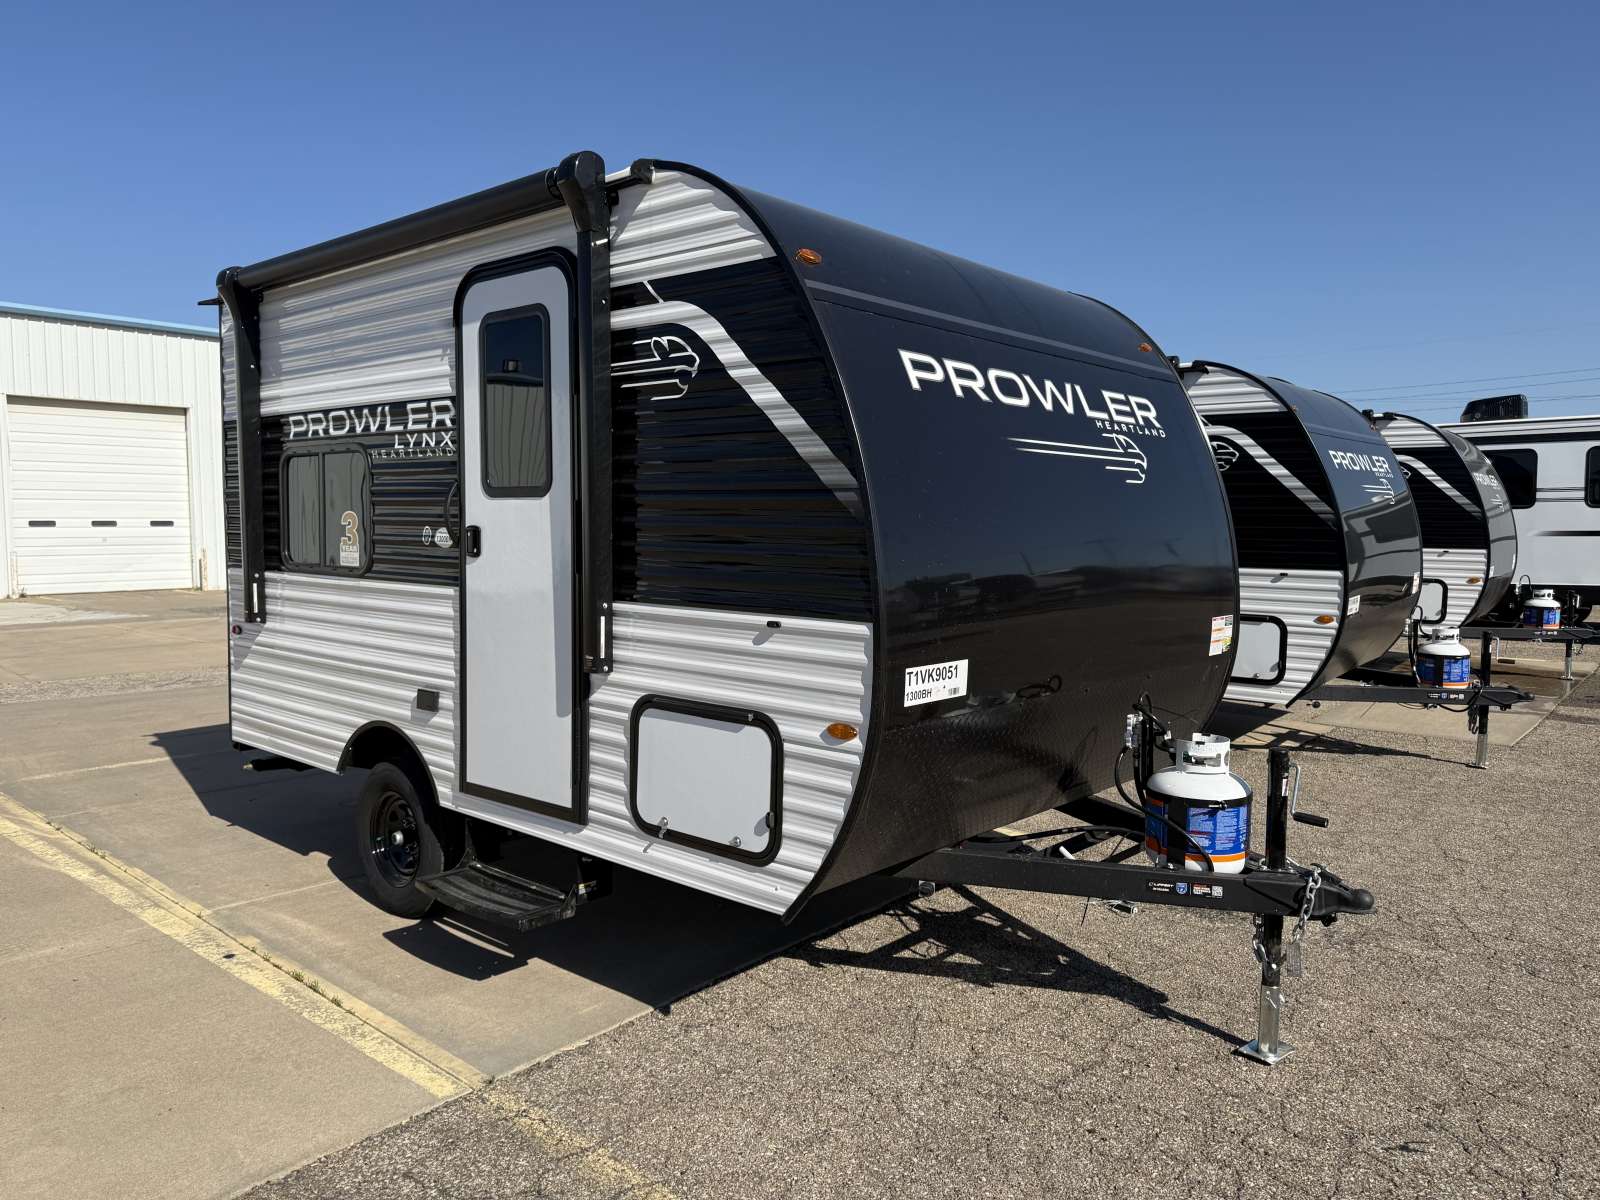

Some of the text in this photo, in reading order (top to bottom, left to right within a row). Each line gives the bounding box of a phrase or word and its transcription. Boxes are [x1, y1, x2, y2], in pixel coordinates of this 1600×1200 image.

[897, 349, 1162, 428] PROWLER
[288, 400, 456, 439] PROWLER
[1095, 420, 1166, 438] HEARTLAND
[394, 431, 456, 449] LYNX
[371, 447, 455, 459] HEARTLAND
[1328, 450, 1391, 472] PROWLER
[341, 510, 358, 544] 3
[906, 665, 958, 687] T1VK9051
[905, 688, 932, 702] 1300BH
